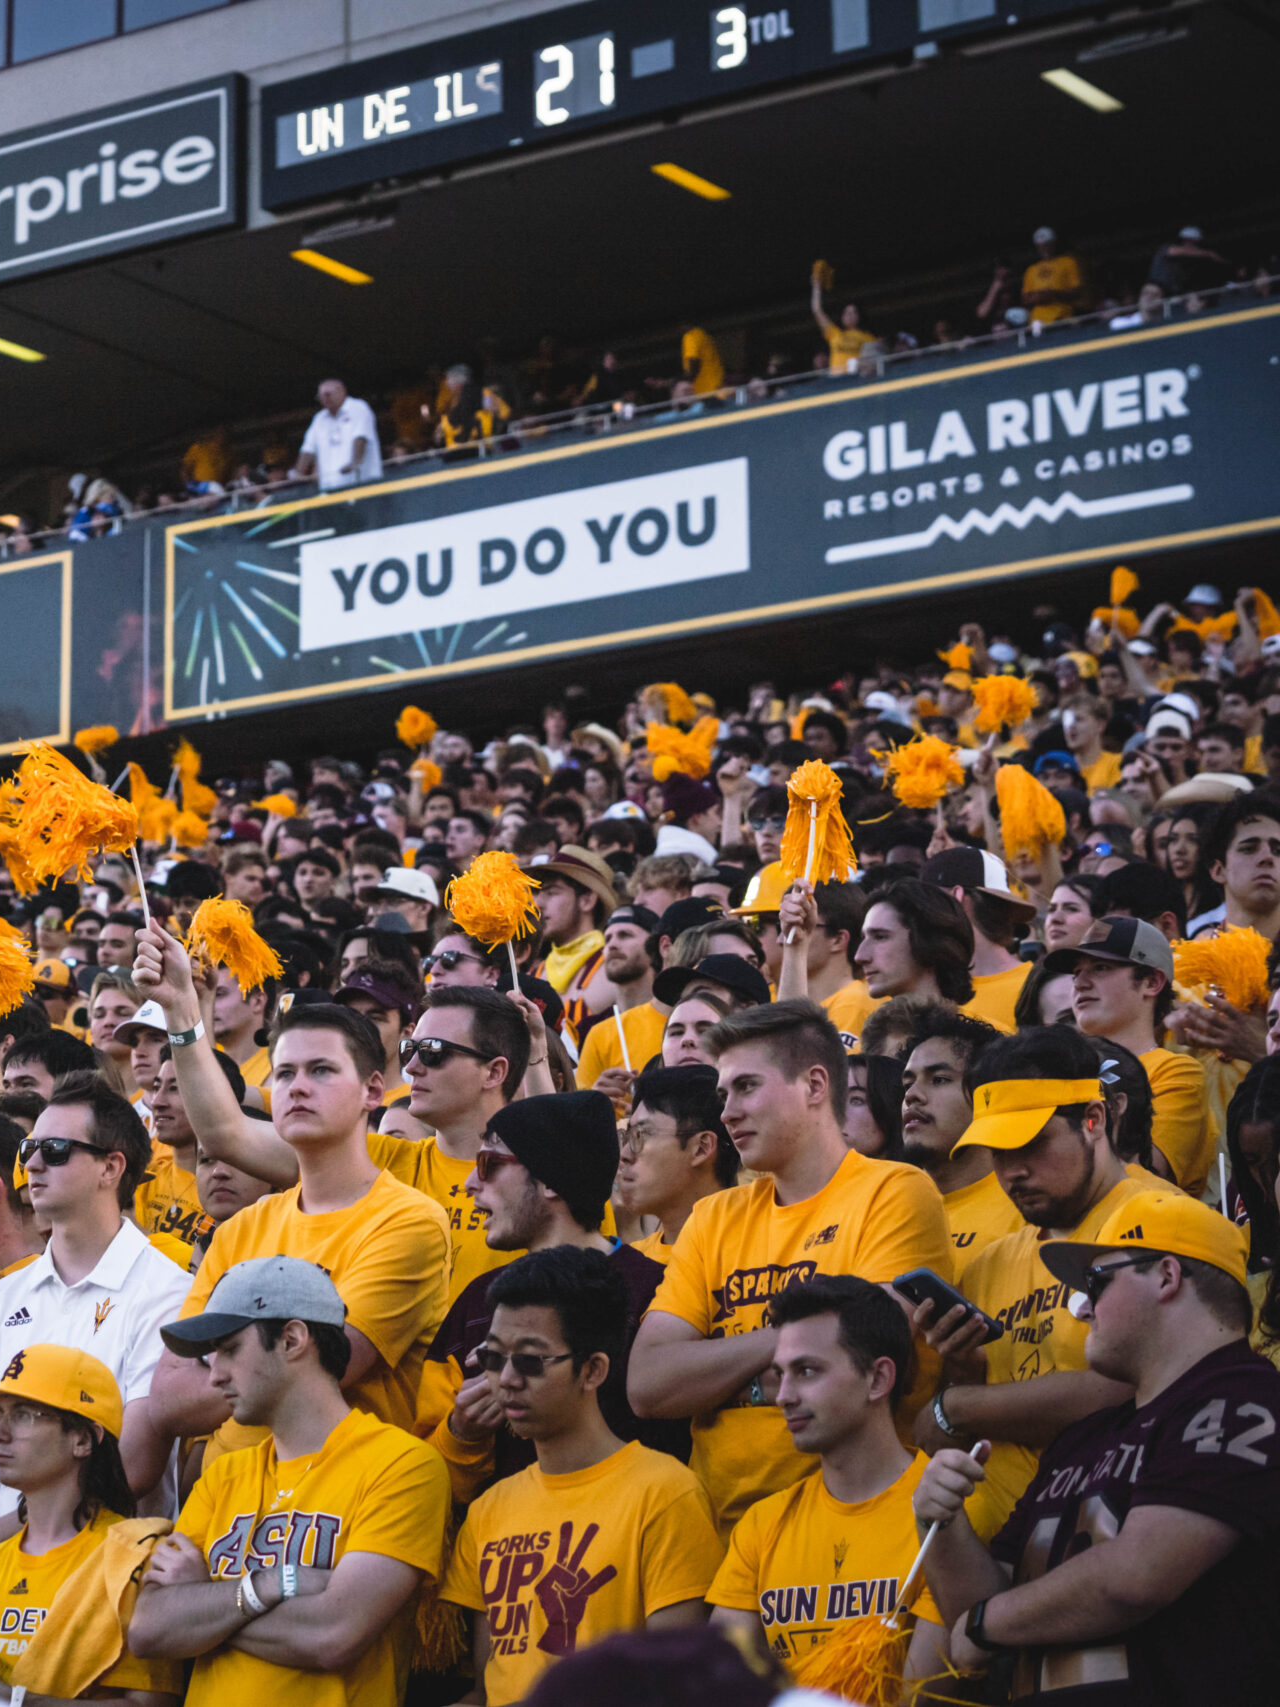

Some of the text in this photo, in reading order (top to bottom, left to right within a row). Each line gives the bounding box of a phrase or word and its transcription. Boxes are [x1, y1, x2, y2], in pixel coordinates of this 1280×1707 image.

[716, 7, 794, 69] 3 TOL
[535, 37, 616, 127] 21
[823, 367, 1190, 481] GILA RIVER
[823, 433, 1194, 520] RESORTS & CASINOS
[331, 495, 718, 613] YOU DO YOU
[4, 1317, 33, 1327] adidas
[1181, 1399, 1276, 1467] 42
[208, 1509, 342, 1577] ASU
[482, 1530, 552, 1558] FORKS
[479, 1551, 545, 1605] UP
[760, 1584, 820, 1628] SUN
[488, 1600, 533, 1637] UN
